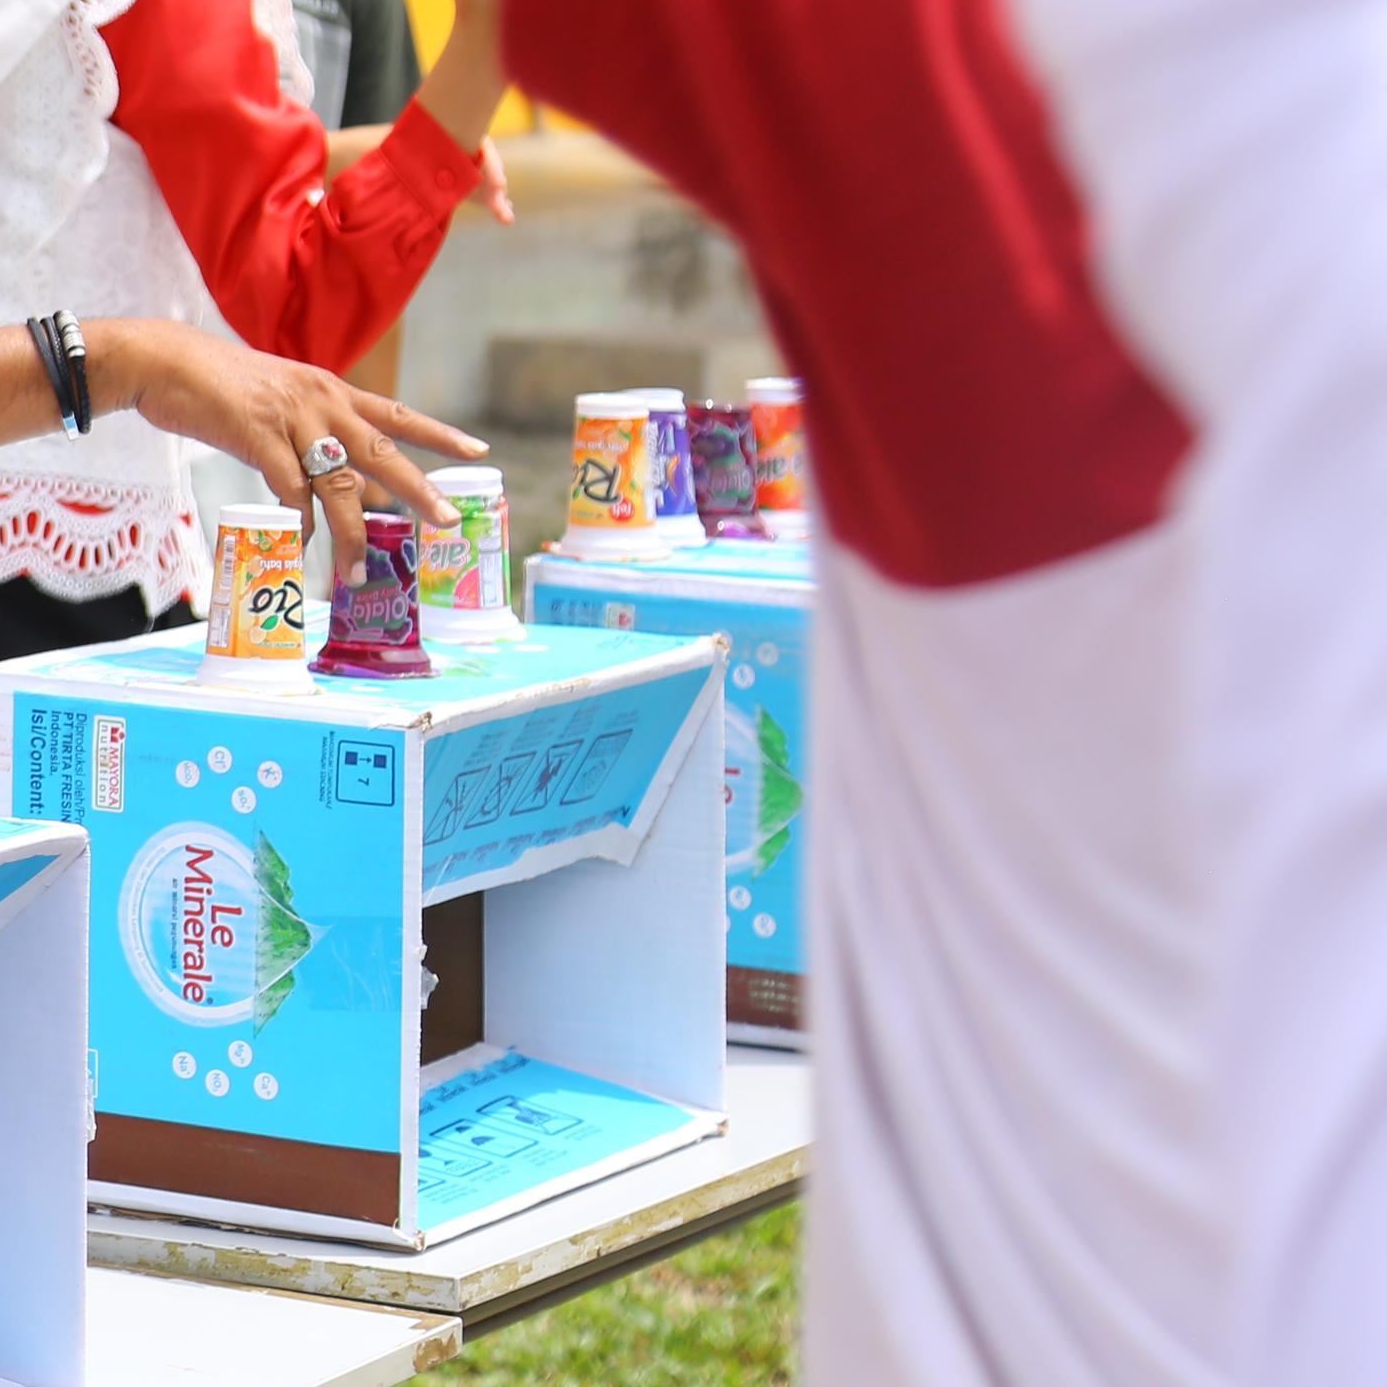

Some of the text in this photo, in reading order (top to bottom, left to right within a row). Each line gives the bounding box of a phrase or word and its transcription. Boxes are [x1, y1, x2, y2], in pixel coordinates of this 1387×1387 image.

[63, 712, 74, 728] PT
[75, 713, 88, 776] Diproduksi
[62, 733, 73, 771] TIRTA
[99, 725, 109, 803] nutrition
[109, 746, 119, 806] MAYORA
[358, 777, 370, 786] 7
[183, 845, 215, 1003] Minerale
[211, 905, 243, 948] Le
